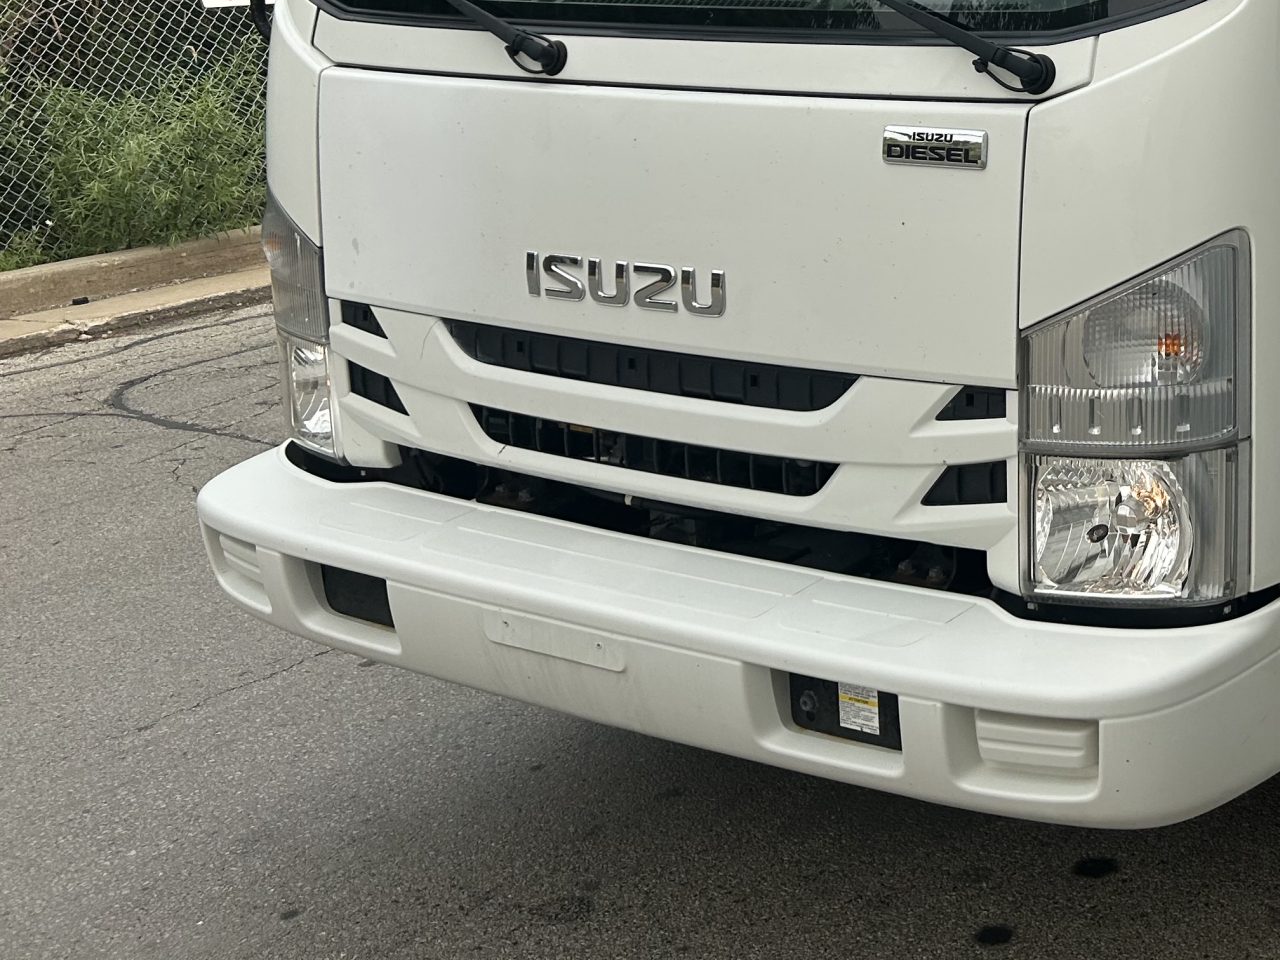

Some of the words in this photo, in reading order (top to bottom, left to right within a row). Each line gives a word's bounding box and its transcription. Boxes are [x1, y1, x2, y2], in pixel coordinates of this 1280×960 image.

[912, 132, 953, 143] ISUZU
[887, 144, 978, 164] DIESEL
[526, 251, 726, 318] ISUZU
